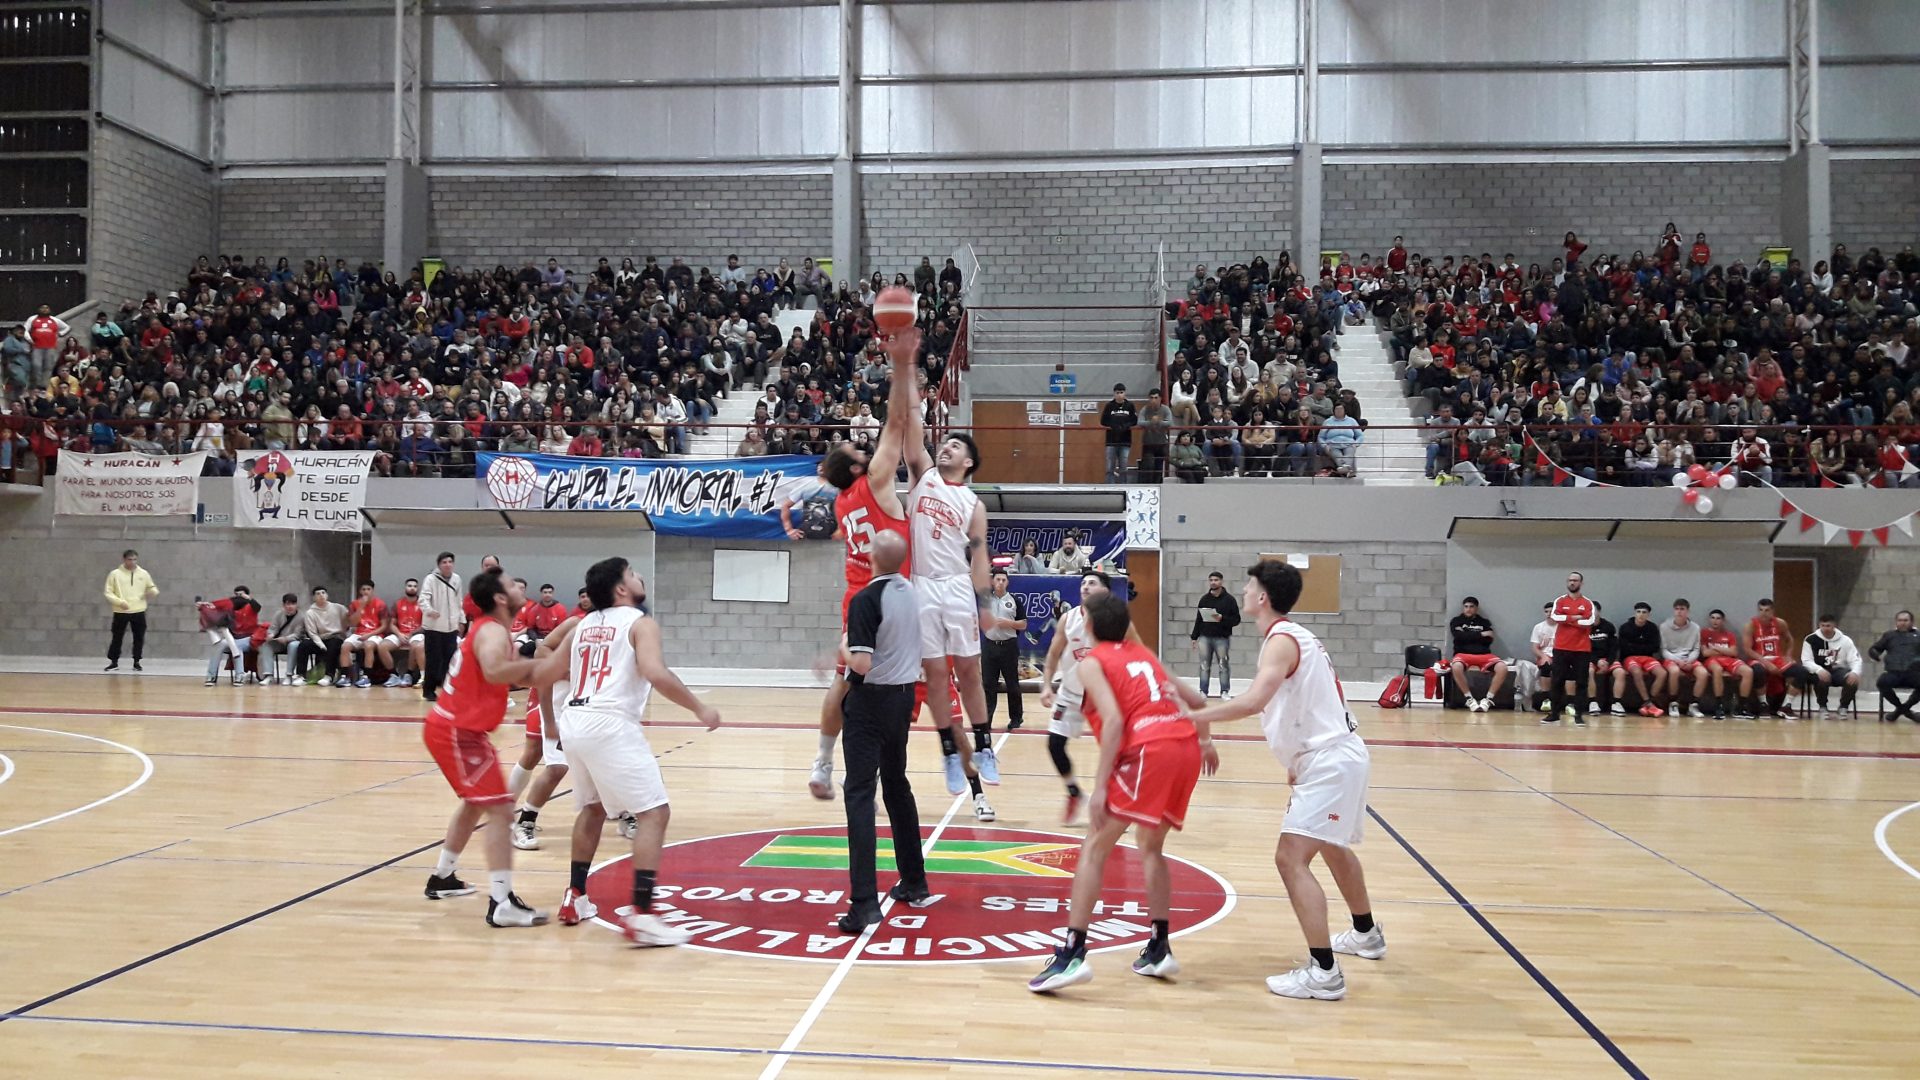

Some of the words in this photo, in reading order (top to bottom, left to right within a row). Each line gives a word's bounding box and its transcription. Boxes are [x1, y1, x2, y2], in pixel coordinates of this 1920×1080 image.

[294, 453, 370, 468] HURACÁN
[63, 476, 84, 486] PARA
[87, 477, 96, 486] EL
[100, 477, 133, 486] MUNDO
[136, 477, 152, 486] SOS
[296, 473, 317, 484] TE
[325, 474, 360, 485] SIGO
[505, 470, 519, 485] H
[80, 490, 100, 499] PARA
[105, 490, 154, 499] NOSOTROS
[159, 490, 175, 498] SOS
[302, 491, 351, 502] DESDE
[544, 466, 609, 510] CHUPA
[610, 467, 636, 509] EL
[641, 467, 742, 516] INMORTAL
[750, 469, 783, 515] #1
[101, 503, 112, 511] EL
[287, 508, 309, 520] LA
[314, 510, 359, 521] CUNA
[573, 645, 613, 699] 14
[1126, 661, 1161, 702] 7
[652, 886, 947, 908] ROYOS
